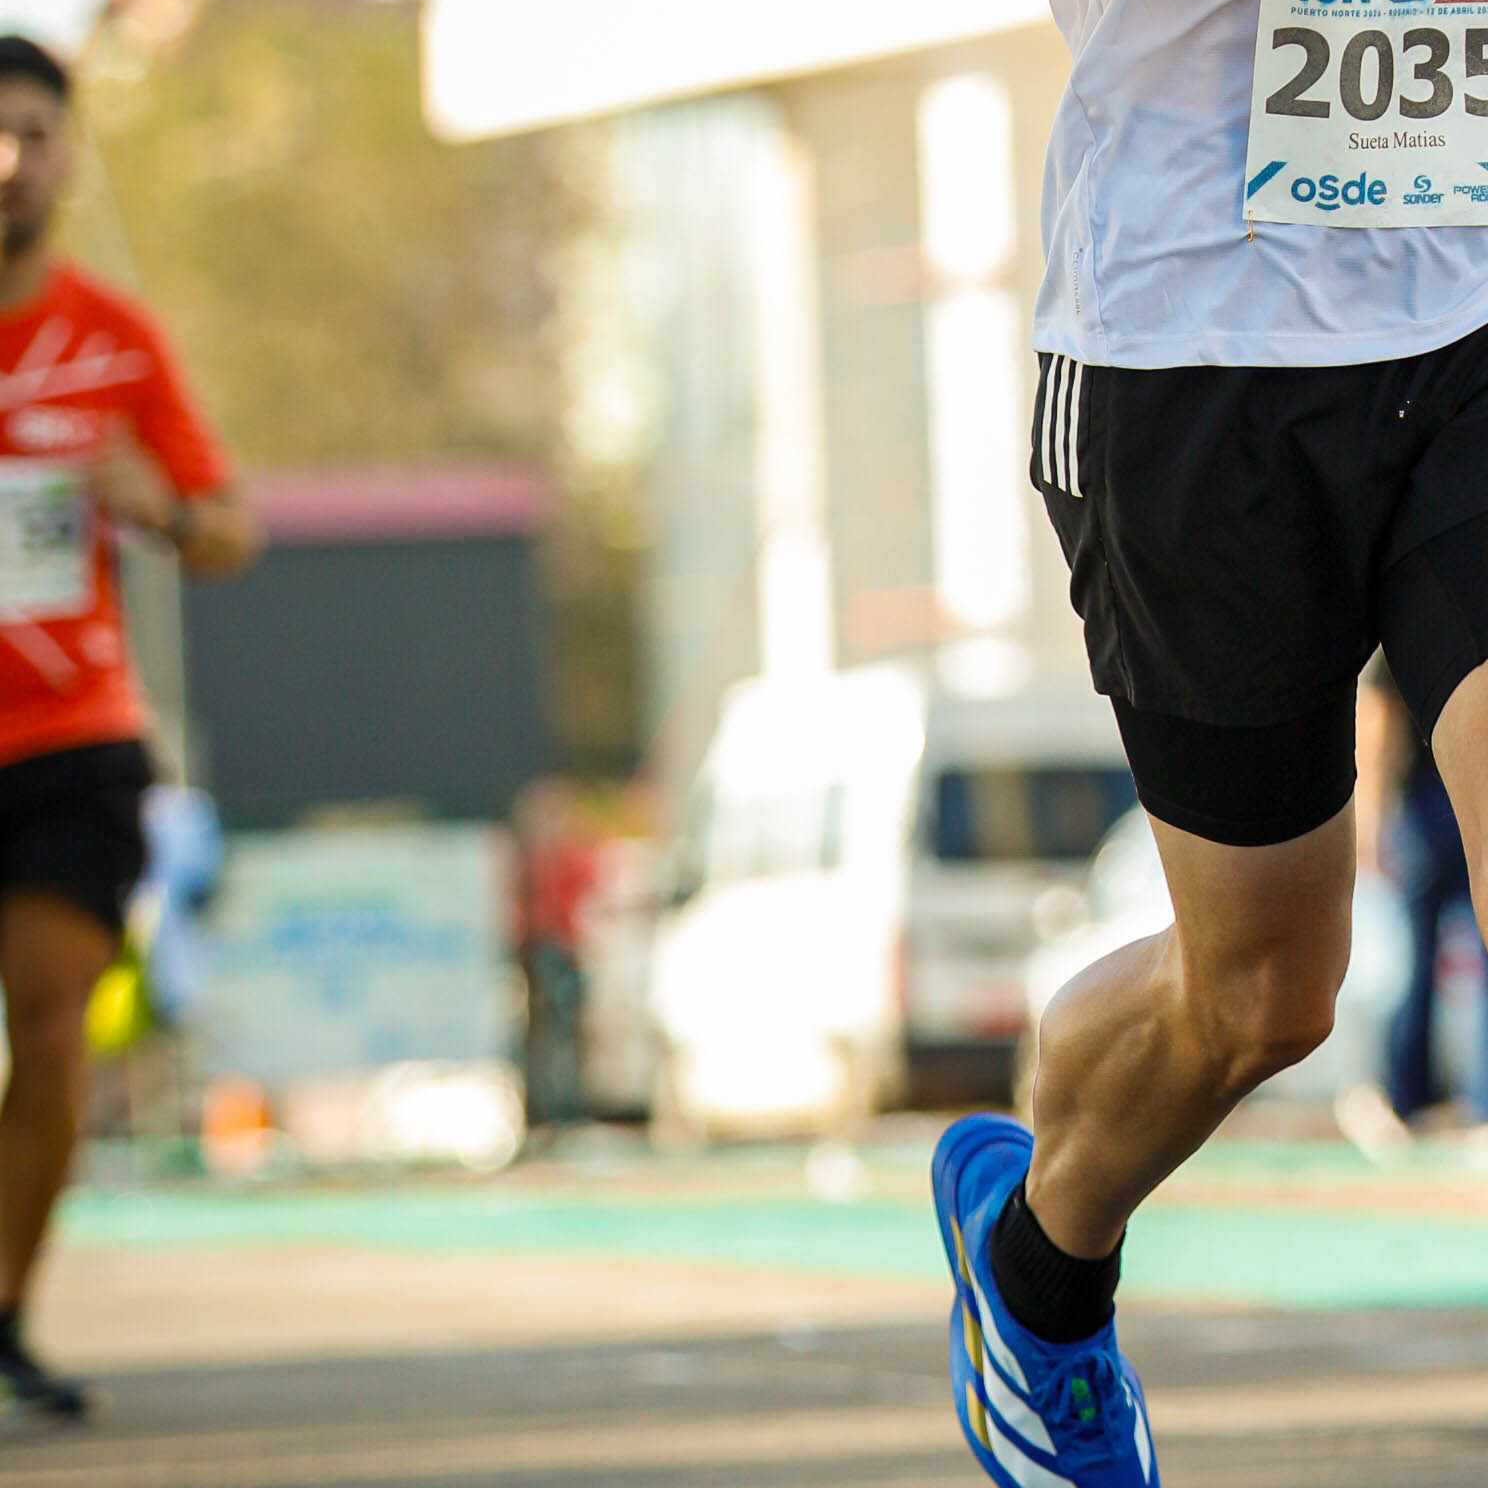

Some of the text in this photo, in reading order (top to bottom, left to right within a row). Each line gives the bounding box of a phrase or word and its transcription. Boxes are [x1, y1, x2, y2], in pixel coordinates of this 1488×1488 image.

[1291, 6, 1328, 17] PUERTO
[1331, 9, 1360, 17] NORTE
[1438, 7, 1448, 15] DE
[1450, 6, 1474, 15] ABRIL
[1349, 131, 1446, 150] Sueta Matias
[1291, 171, 1388, 207] osde
